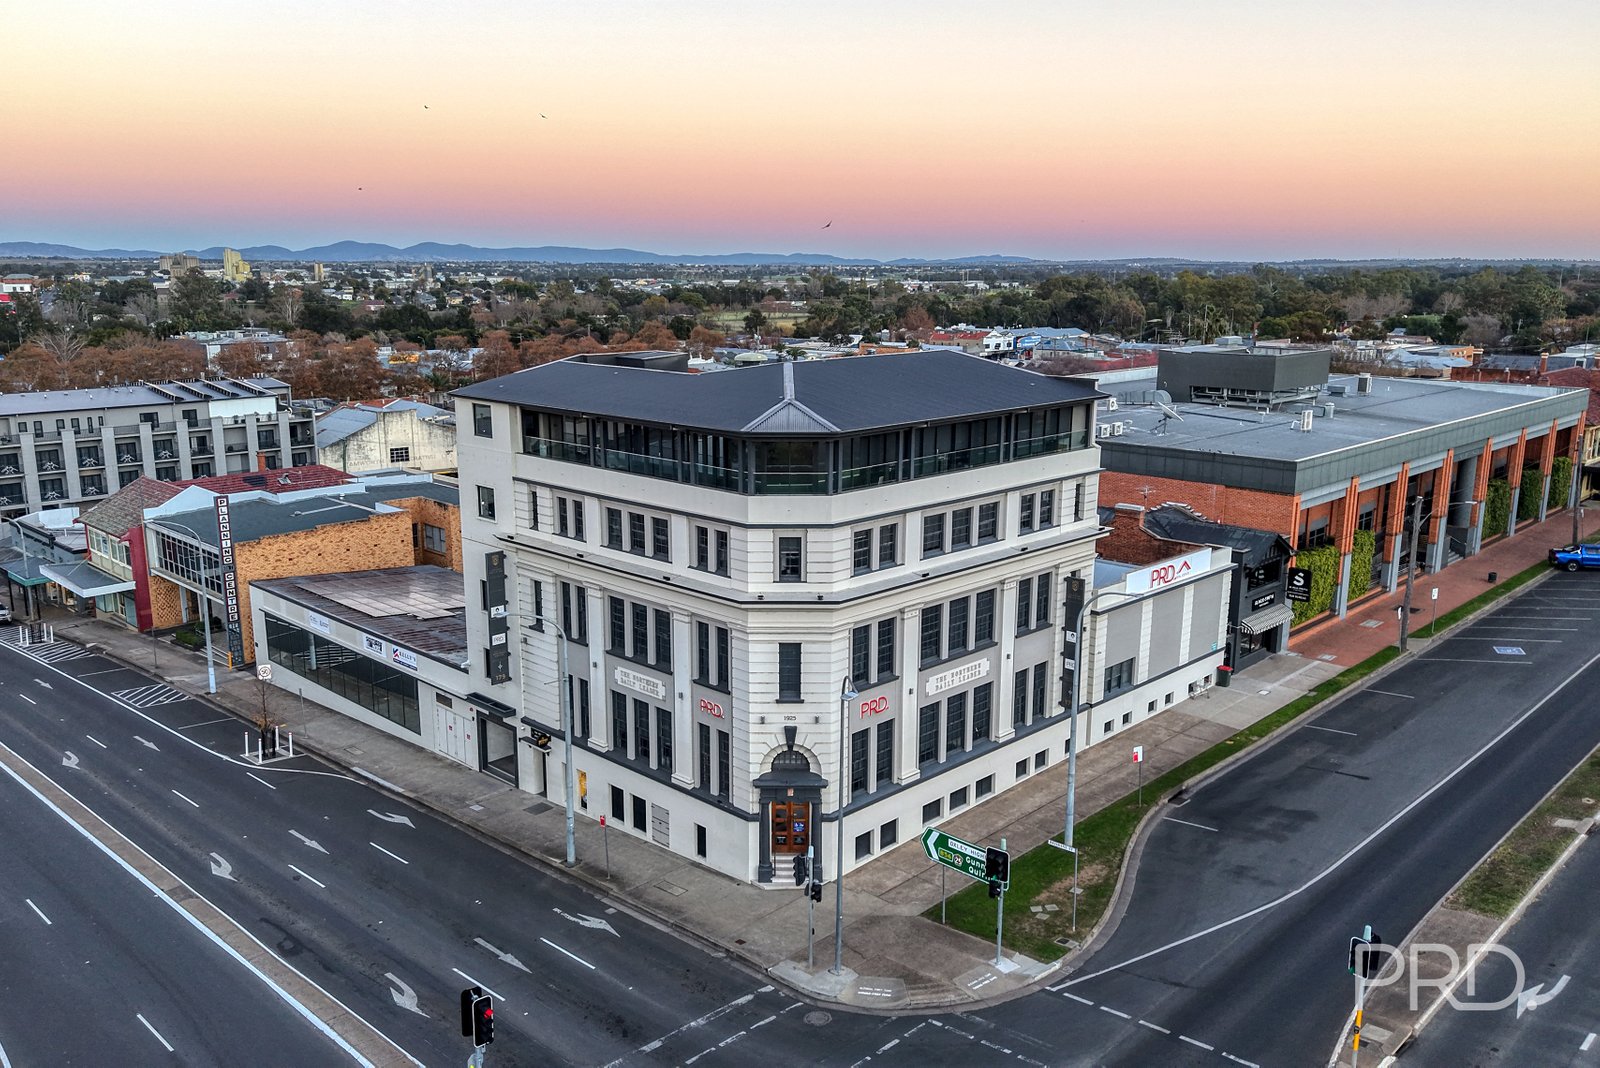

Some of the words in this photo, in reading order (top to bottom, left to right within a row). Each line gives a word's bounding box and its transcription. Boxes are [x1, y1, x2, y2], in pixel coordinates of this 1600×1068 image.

[218, 498, 233, 564] PLANNING
[225, 573, 239, 621] CENTRE
[620, 670, 630, 678] THE
[936, 675, 947, 683] THE
[951, 663, 981, 678] NORTHERN
[936, 679, 955, 691] DAILY
[958, 670, 981, 683] LEADER
[949, 841, 968, 852] OXLEY
[970, 849, 987, 860] HIGH
[965, 856, 986, 870] Gunn
[968, 866, 990, 881] Quir
